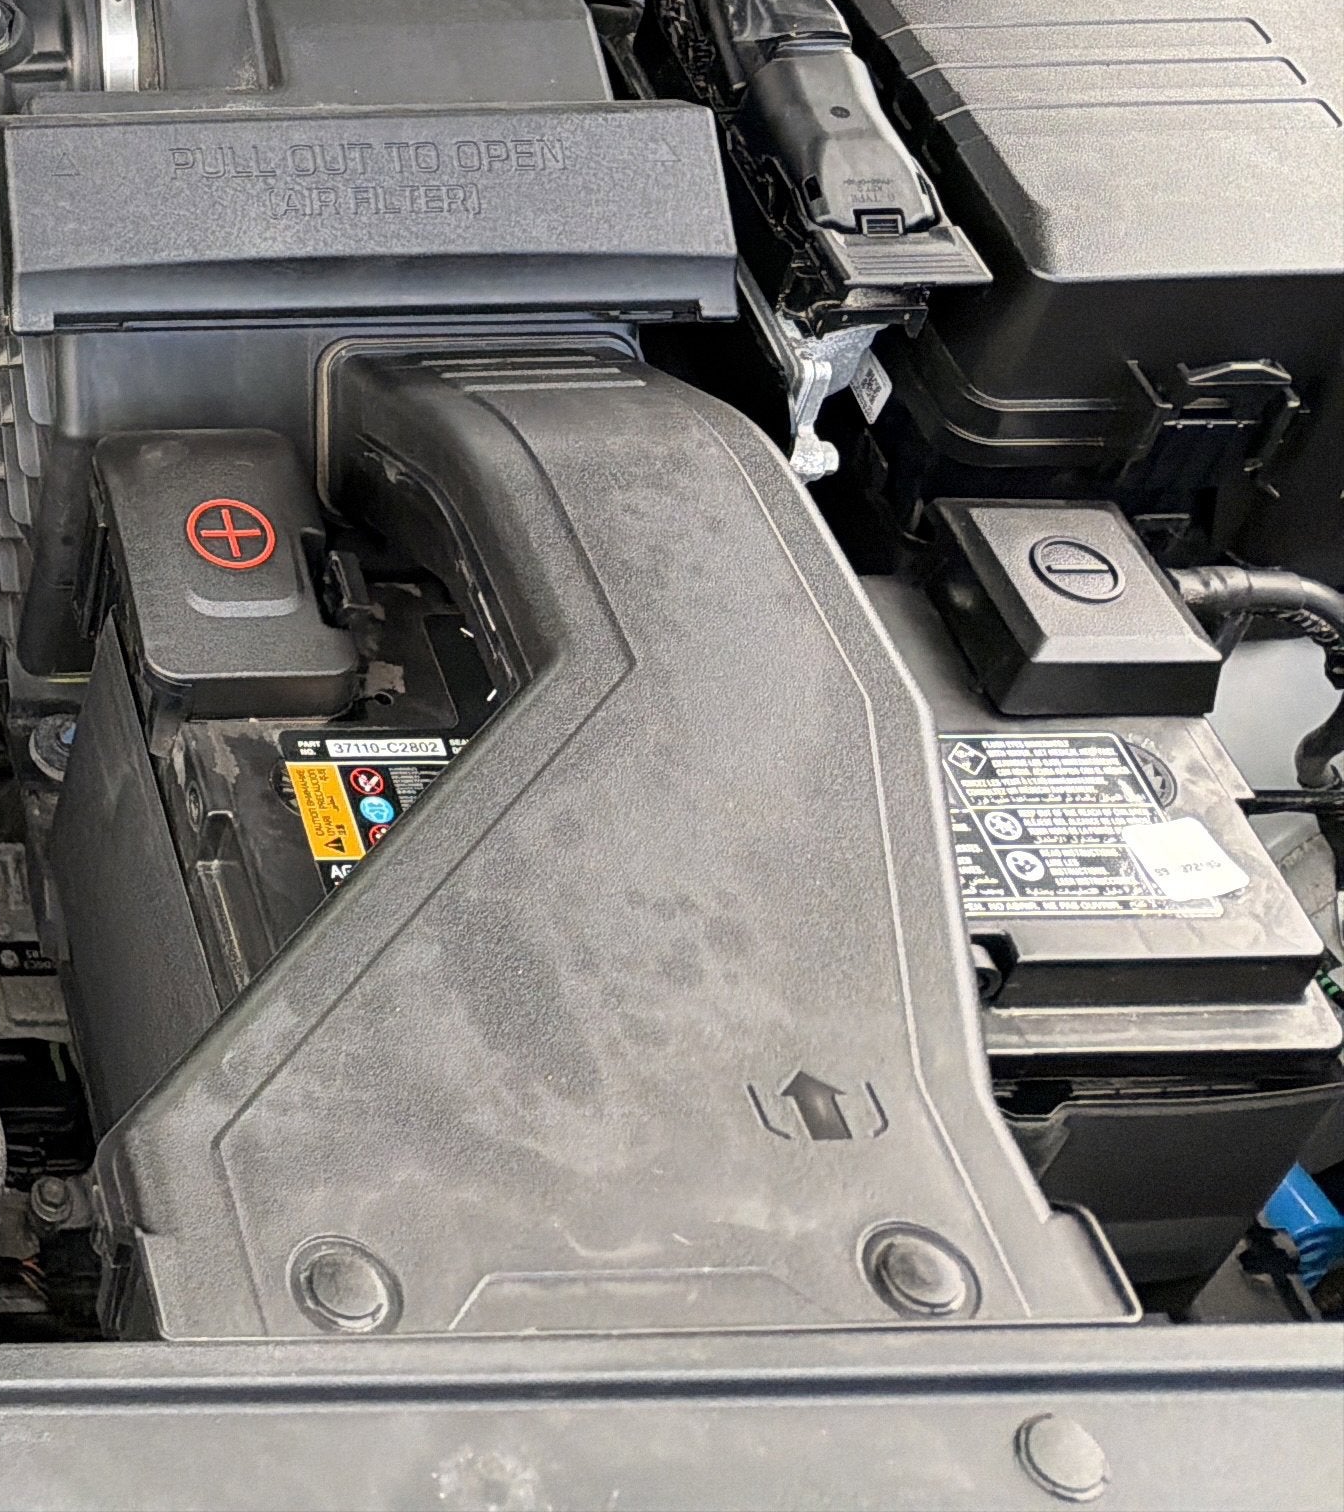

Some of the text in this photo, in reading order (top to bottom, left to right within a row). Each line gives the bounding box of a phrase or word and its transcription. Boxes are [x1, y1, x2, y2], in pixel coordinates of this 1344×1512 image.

[168, 138, 567, 180] PULL OUT TO OPEN
[268, 182, 483, 221] (AIR FILTER)
[297, 739, 321, 748] PART
[333, 741, 441, 755] 37110-C2802
